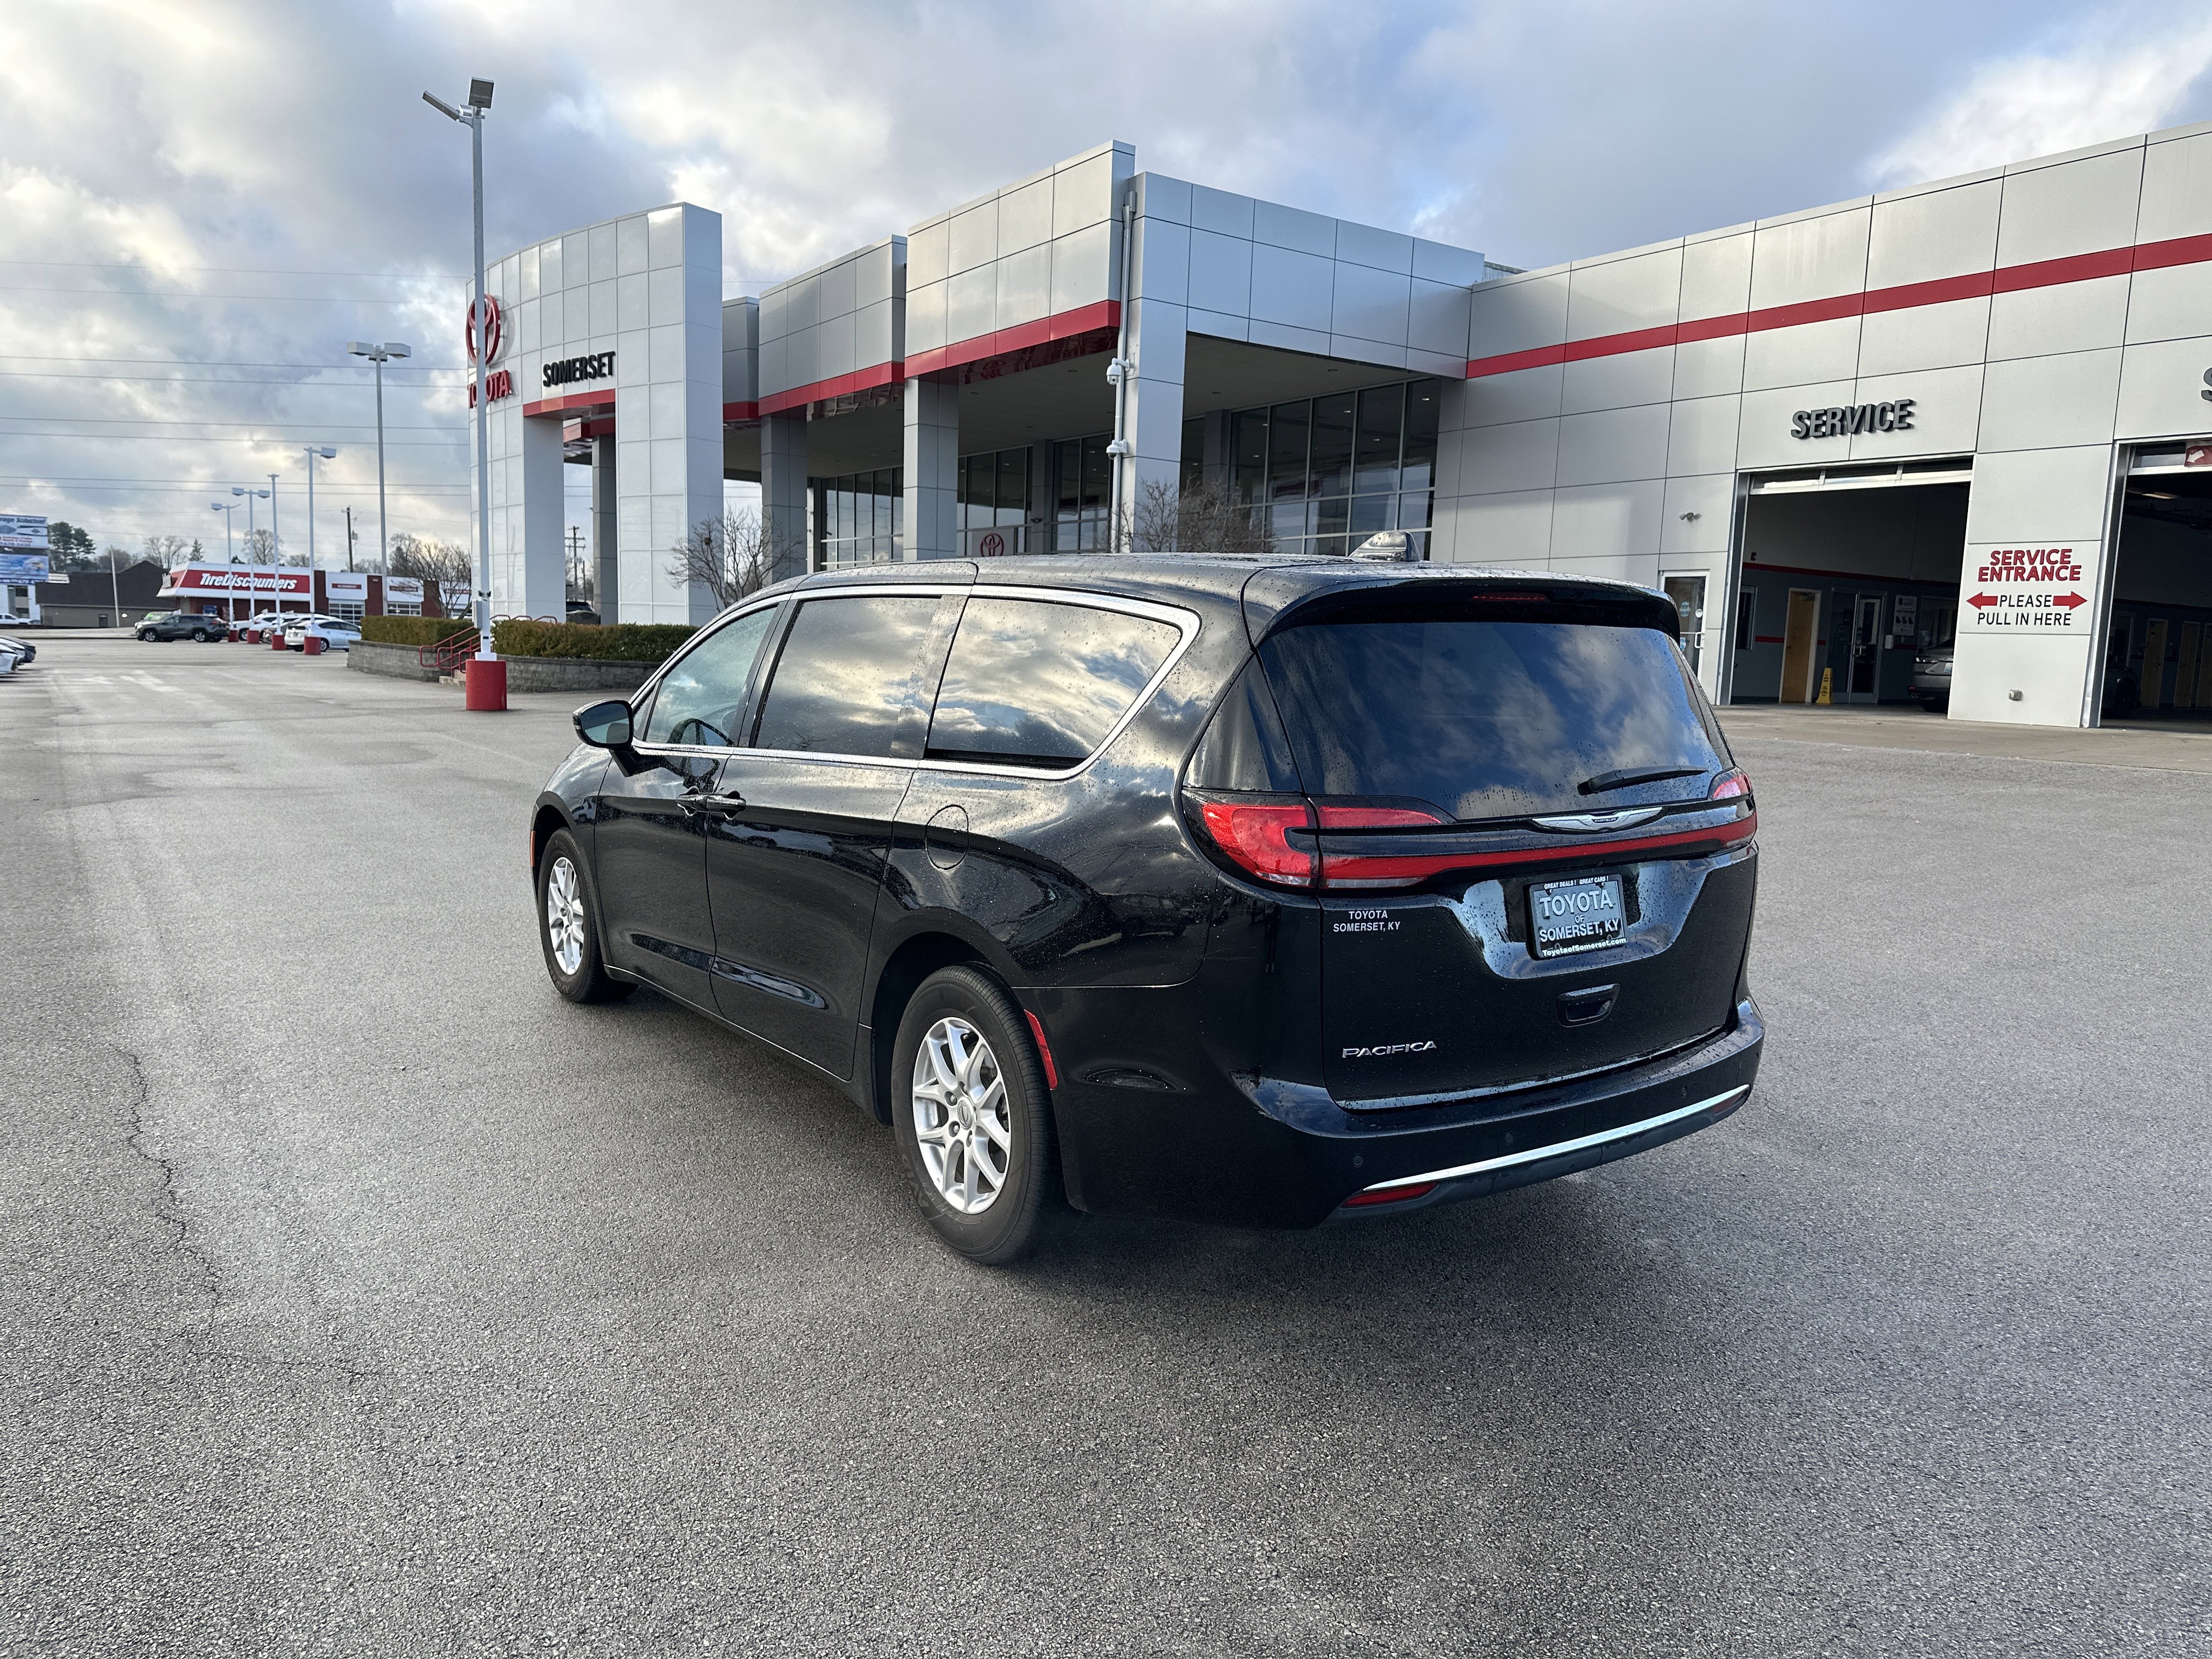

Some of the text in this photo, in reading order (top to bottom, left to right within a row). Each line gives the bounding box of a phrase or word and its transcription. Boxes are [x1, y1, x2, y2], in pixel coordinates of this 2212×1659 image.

[543, 351, 616, 387] SOMERSET
[467, 369, 512, 408] TOOTA
[1791, 399, 1913, 439] SERVICE
[1990, 549, 2072, 566] SERVICE
[1978, 565, 2082, 582] ENTRANCE
[1999, 594, 2052, 607] PLEASE
[1978, 612, 2072, 625] PULL IN HERE
[1539, 889, 1613, 919] TOYOTA
[1348, 910, 1388, 919] TOYOTA
[1575, 914, 1585, 924] OF
[1333, 921, 1401, 932] SOMERSET, KY
[1539, 918, 1619, 943] SOMERSET, KY
[1542, 938, 1627, 957] ToyotaofSomerset.com
[1342, 1040, 1437, 1058] PACIFICA
